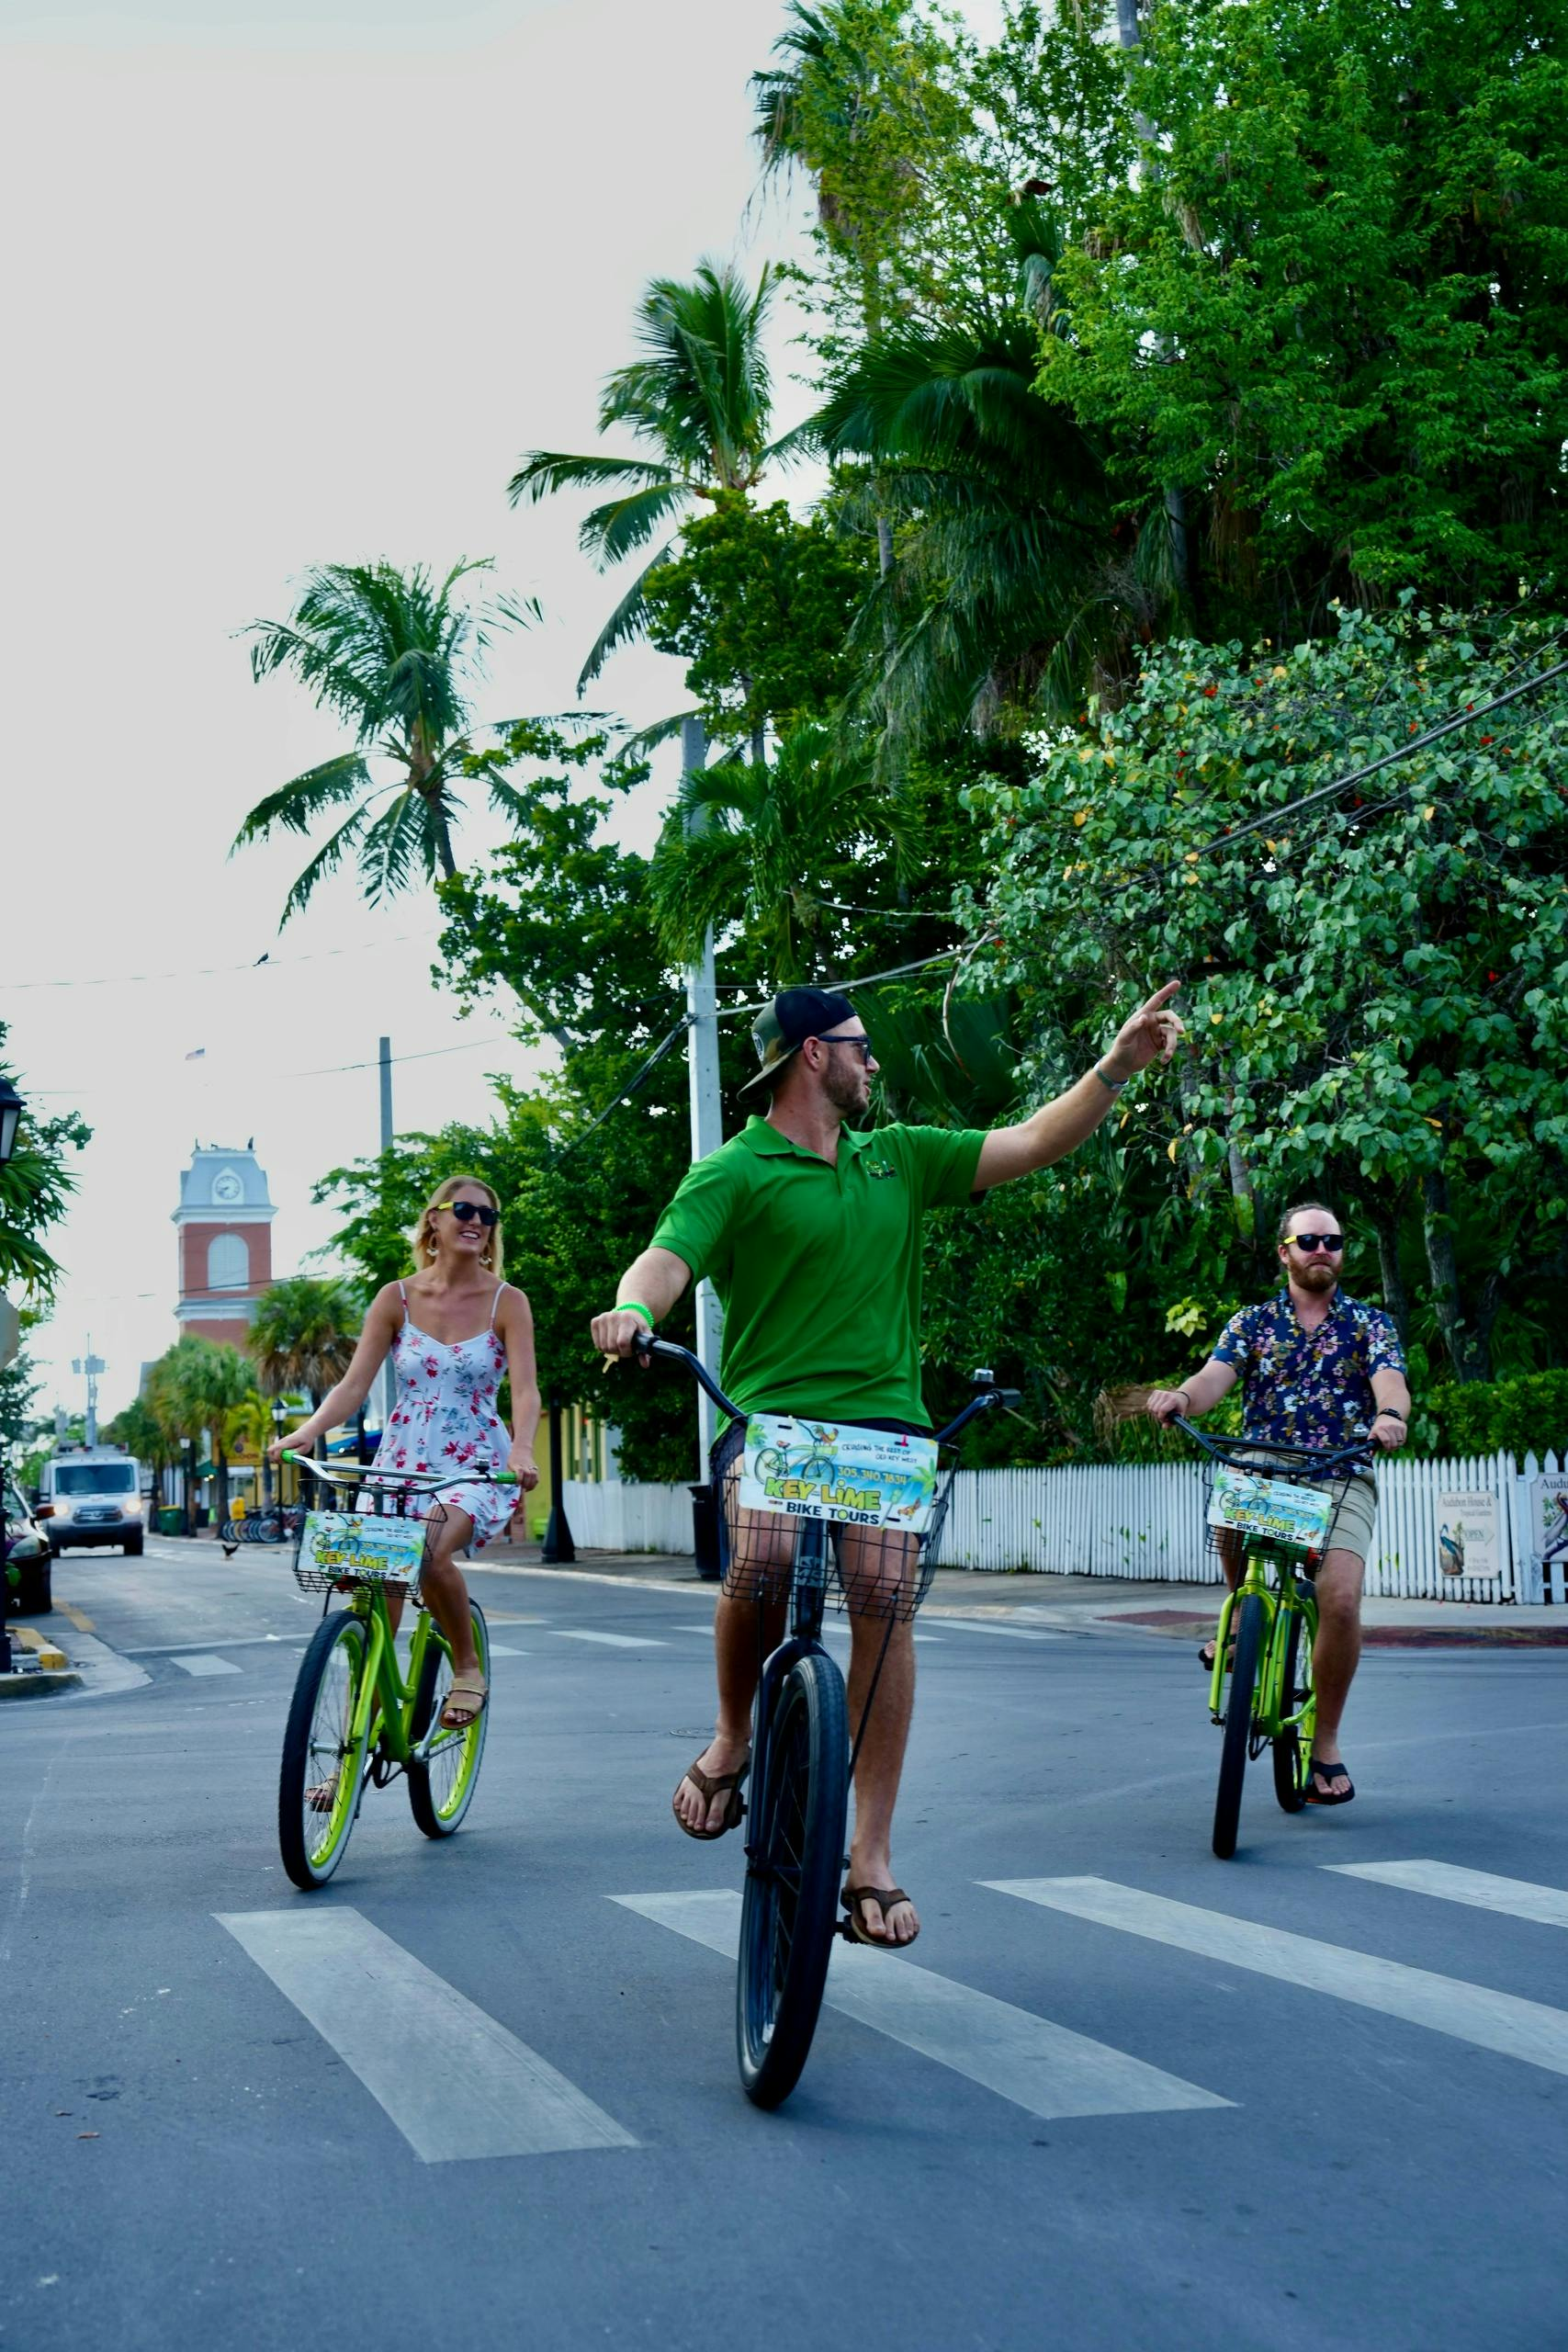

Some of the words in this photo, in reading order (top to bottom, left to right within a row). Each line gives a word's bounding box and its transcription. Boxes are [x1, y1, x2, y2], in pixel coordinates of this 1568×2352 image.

[764, 1476, 817, 1501] KEY
[1468, 1496, 1485, 1507] House
[1486, 1496, 1492, 1507] &
[786, 1501, 822, 1517] BIKE
[829, 1508, 880, 1526] TOURS
[1224, 1507, 1255, 1523] KEY
[1236, 1521, 1258, 1533] BIKE
[1262, 1527, 1294, 1542] TOURS
[1464, 1530, 1484, 1538] OPEN
[314, 1549, 348, 1565] KEY
[328, 1566, 350, 1575] BIKE
[355, 1568, 387, 1579] TOURS
